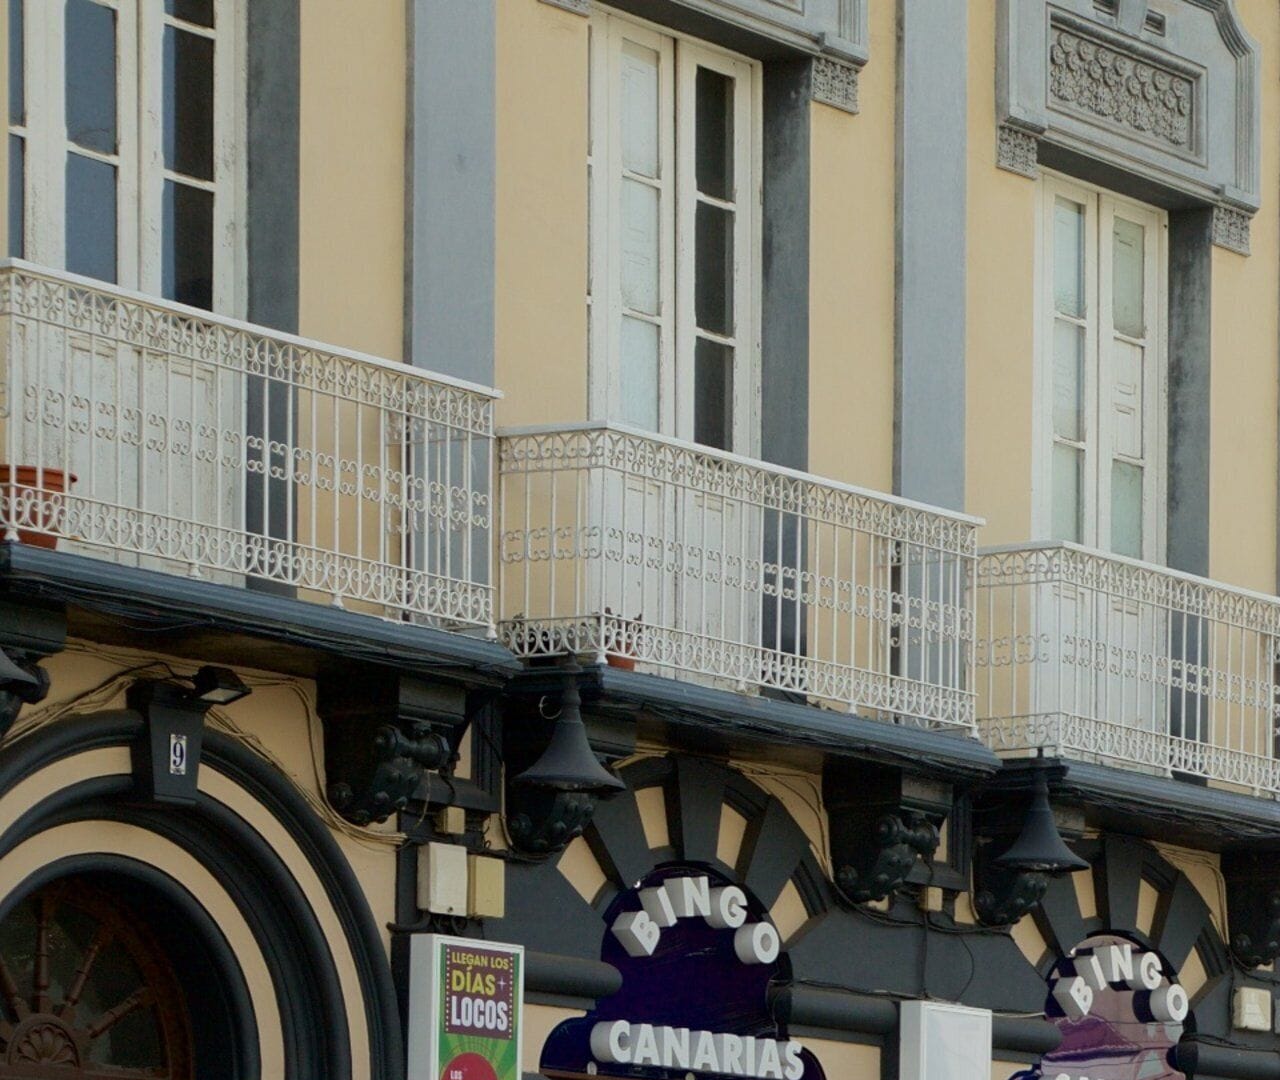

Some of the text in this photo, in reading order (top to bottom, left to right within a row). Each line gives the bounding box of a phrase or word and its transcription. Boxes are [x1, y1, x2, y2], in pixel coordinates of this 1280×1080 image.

[172, 741, 184, 768] 9
[626, 876, 780, 965] BINGO
[451, 951, 510, 970] LLEGAN LOS
[451, 967, 496, 996] DÍAS
[1067, 943, 1189, 1022] BINGO
[451, 995, 509, 1032] LOCOS
